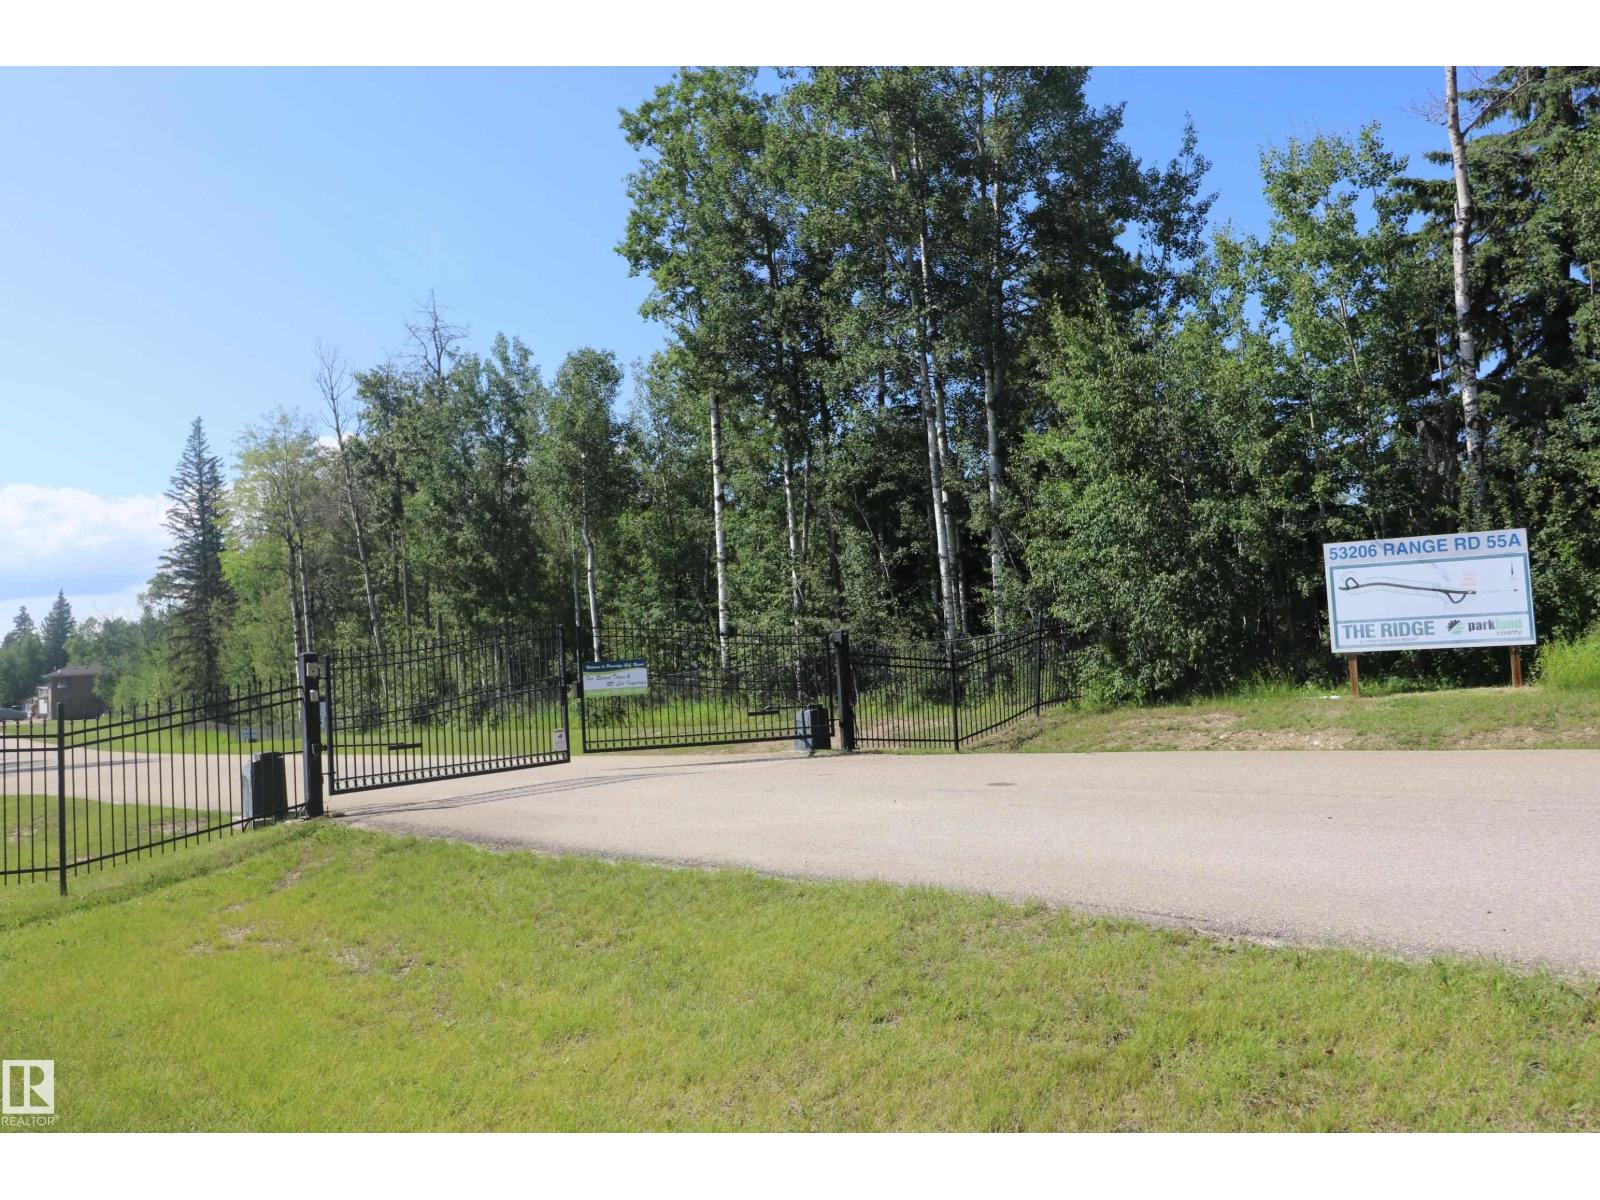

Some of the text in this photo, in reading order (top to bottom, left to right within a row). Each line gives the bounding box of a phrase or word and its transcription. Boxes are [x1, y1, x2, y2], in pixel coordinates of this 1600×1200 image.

[1329, 533, 1521, 560] 53206 RANGE RD 55A
[1342, 620, 1436, 639] THE RIDGE
